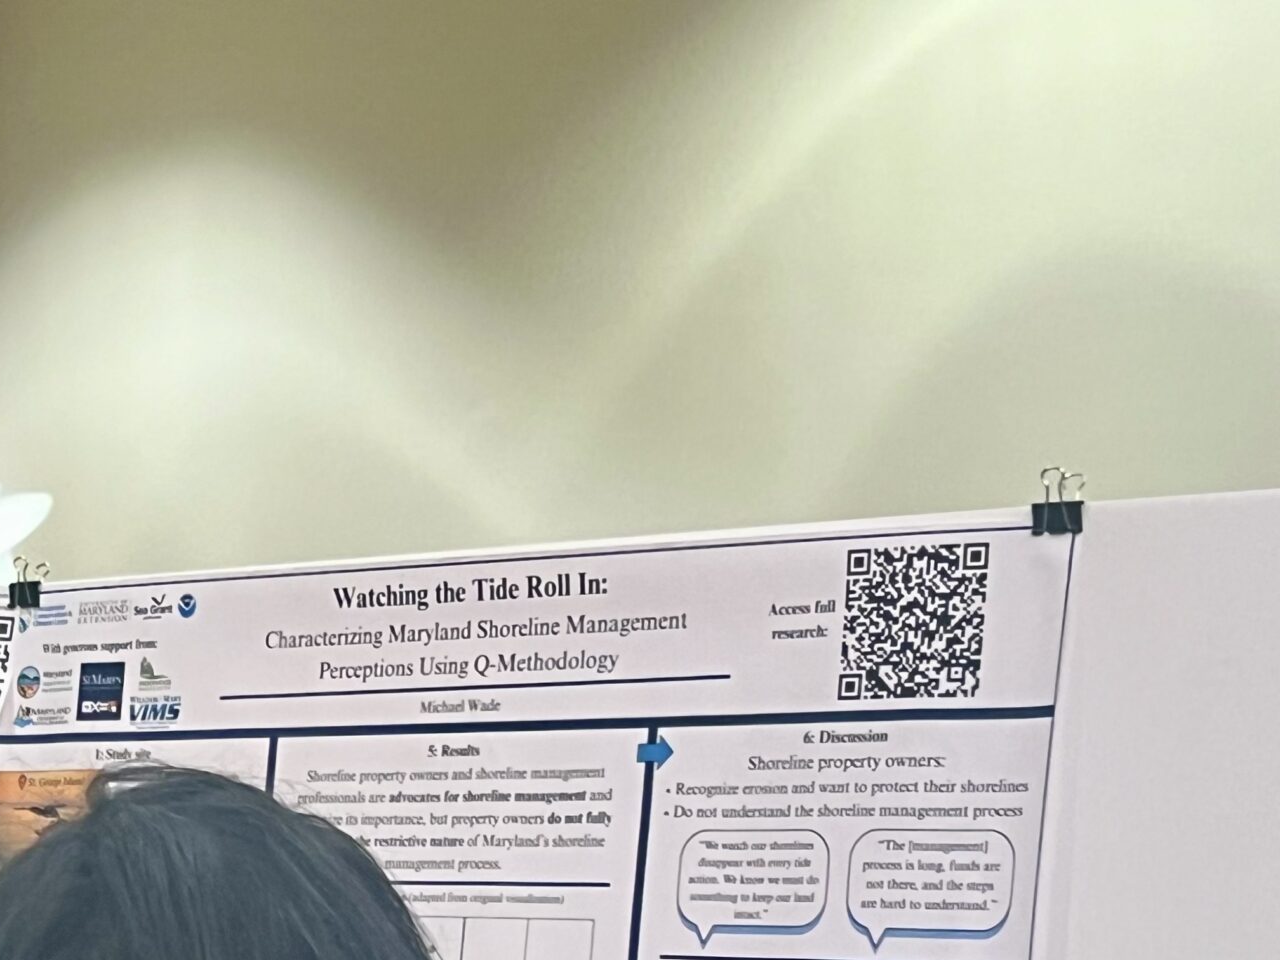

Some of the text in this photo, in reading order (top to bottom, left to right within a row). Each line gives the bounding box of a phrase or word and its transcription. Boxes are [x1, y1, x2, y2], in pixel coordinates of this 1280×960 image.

[333, 573, 607, 610] Watching the Tide Roll In:
[134, 605, 148, 616] Sea
[769, 600, 835, 617] Access full
[266, 613, 687, 649] Characterizing Maryland Shoreline Management
[772, 626, 828, 639] research:
[101, 641, 132, 653] support
[320, 651, 619, 683] Perceptions Using Q-Methodology
[130, 703, 180, 721] VIMS
[421, 700, 501, 713] Michael Wade
[803, 730, 888, 744] 6: Discussion
[106, 749, 132, 760] Study
[135, 749, 151, 759] site
[428, 744, 480, 757] 5: Results
[748, 755, 814, 770] Shoreline
[818, 756, 881, 772] property
[307, 770, 356, 782] Shoreline
[359, 771, 407, 784] property
[409, 771, 448, 780] owners
[452, 768, 472, 780] and
[475, 768, 527, 780] shoreline
[676, 779, 1029, 797] Recognize erosion and want to protect their shorelines
[298, 789, 612, 804] professionals are advocates for shoreline management and
[346, 815, 357, 825] its
[361, 815, 426, 828] importance,
[430, 813, 447, 825] but
[451, 815, 499, 827] property
[503, 814, 544, 824] owners
[548, 812, 561, 824] do
[565, 814, 583, 824] not
[586, 812, 611, 827] fully
[674, 804, 1023, 820] Do not understand the shoreline management process
[374, 834, 605, 850] restrictive nature of Maryland's shoreline
[385, 860, 454, 871] management
